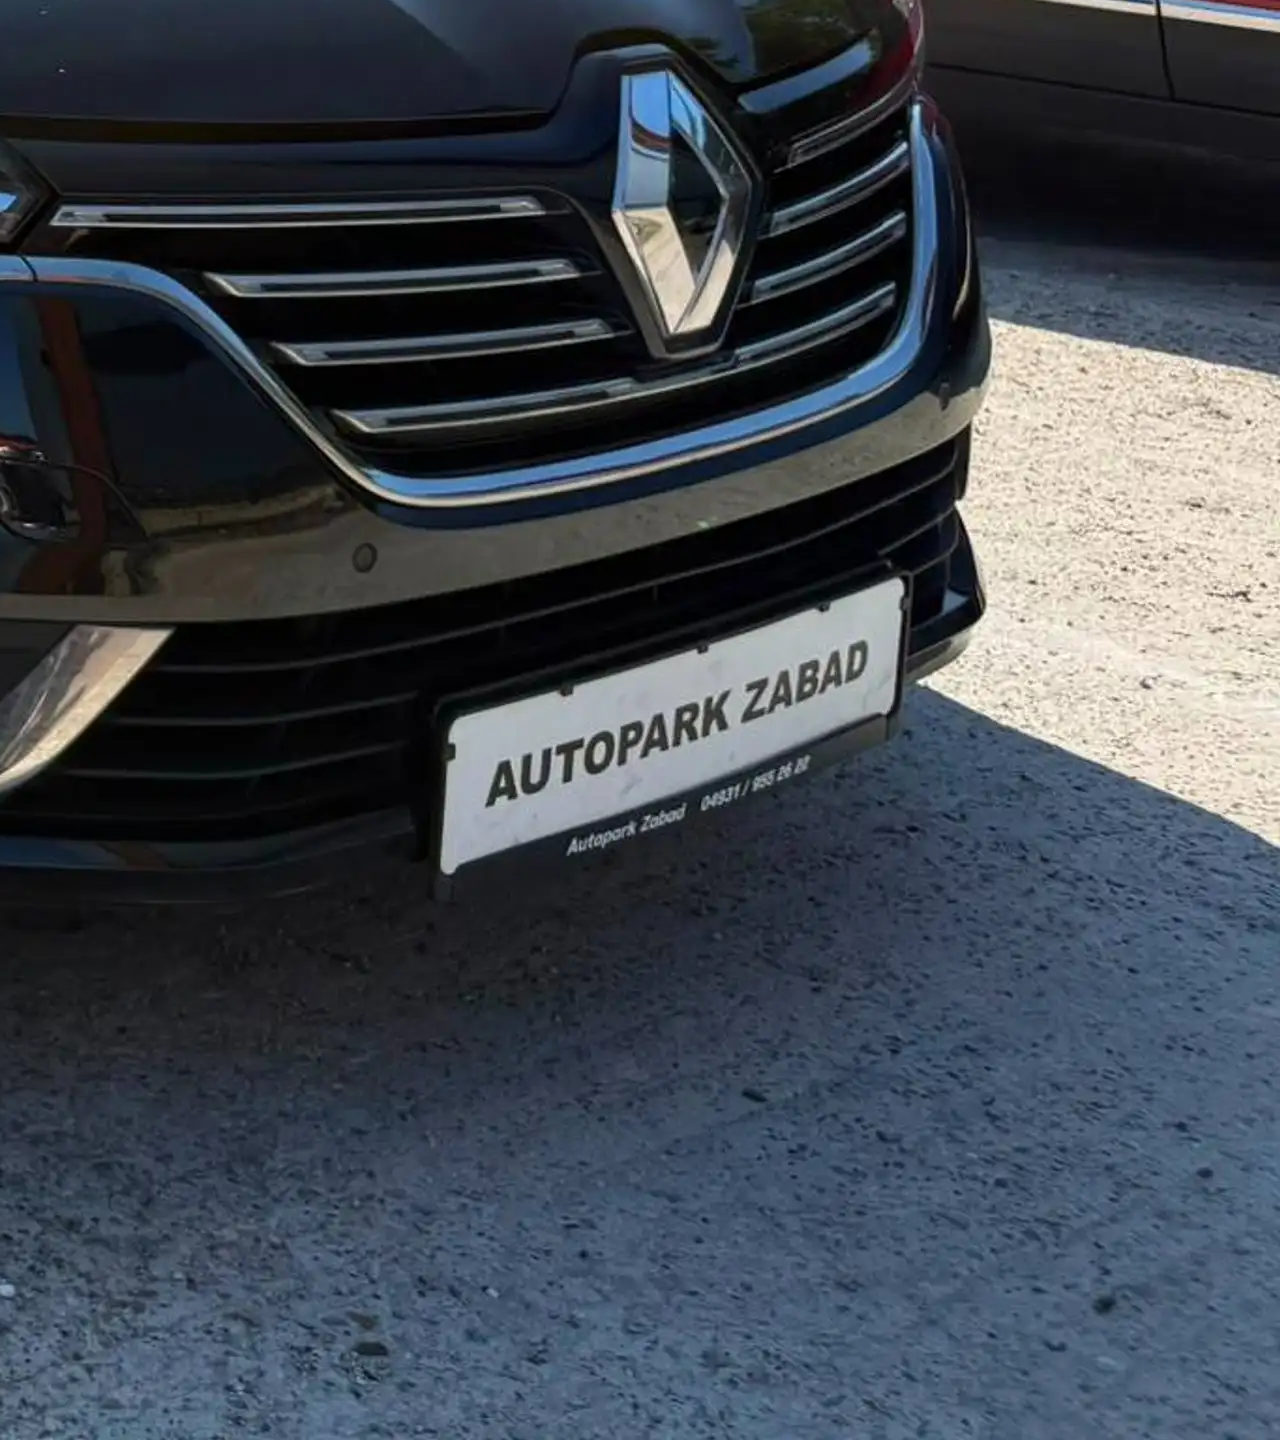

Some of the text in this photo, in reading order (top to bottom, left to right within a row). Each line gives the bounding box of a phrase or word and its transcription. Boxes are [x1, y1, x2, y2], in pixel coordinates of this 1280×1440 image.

[484, 640, 870, 808] AUTOPARK ZABAD
[566, 820, 638, 857] Autopark
[640, 802, 687, 832] Zabad
